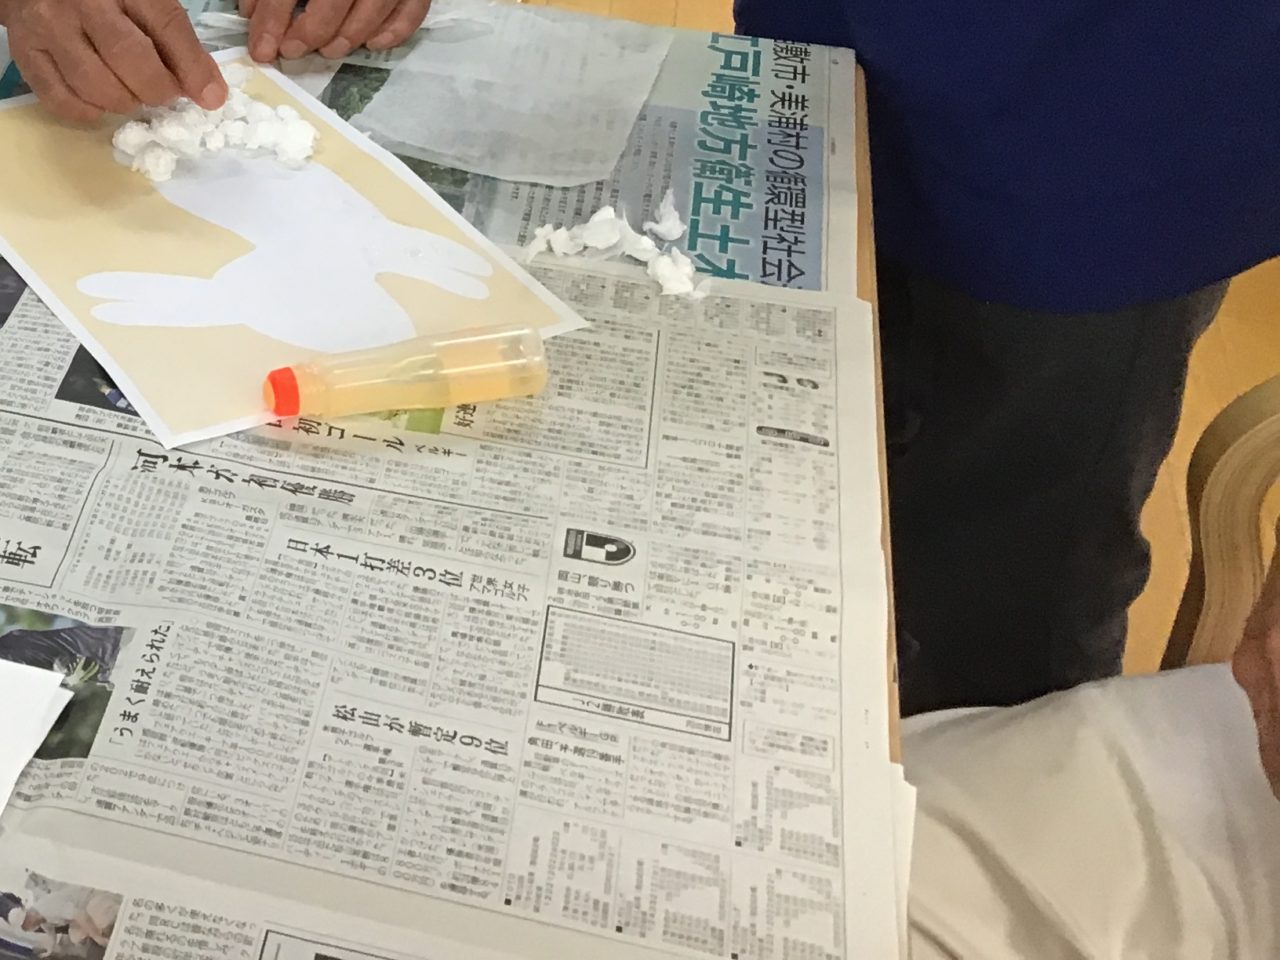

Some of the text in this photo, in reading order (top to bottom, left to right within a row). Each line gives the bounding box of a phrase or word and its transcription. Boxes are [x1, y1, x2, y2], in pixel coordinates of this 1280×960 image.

[413, 442, 469, 459] ベルギー
[286, 537, 465, 589] 日本1打差3位
[331, 704, 510, 757] 松山が暫定9位
